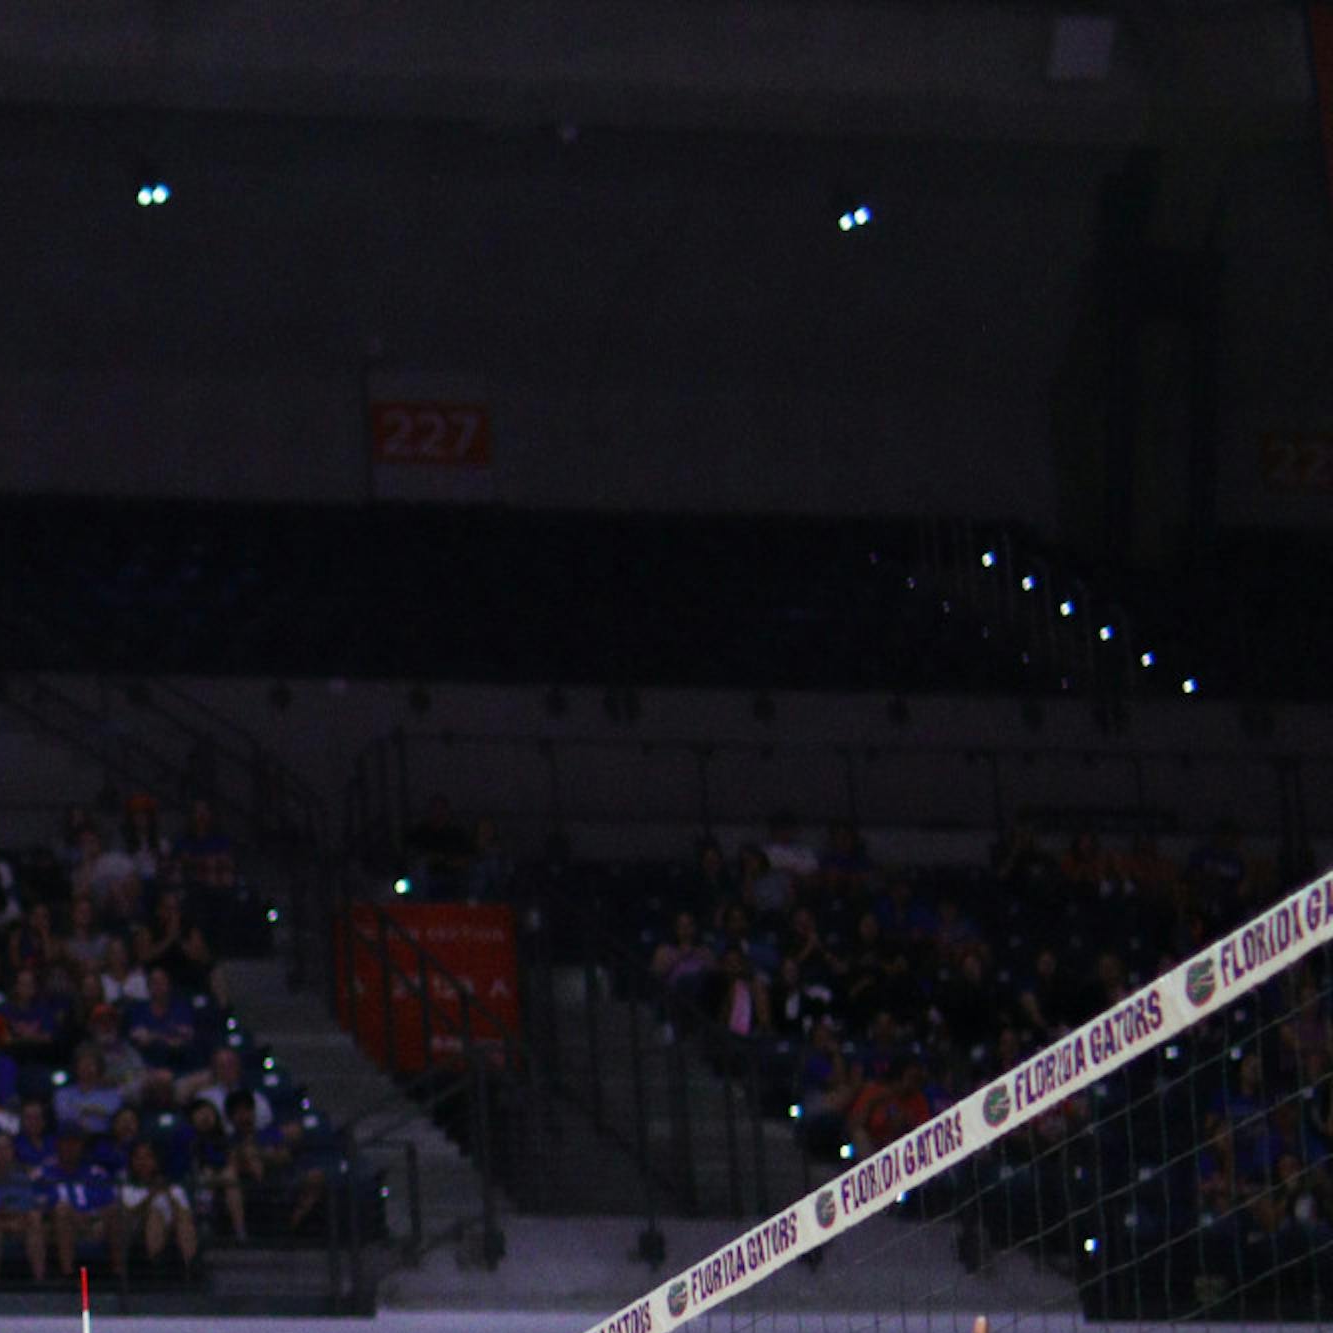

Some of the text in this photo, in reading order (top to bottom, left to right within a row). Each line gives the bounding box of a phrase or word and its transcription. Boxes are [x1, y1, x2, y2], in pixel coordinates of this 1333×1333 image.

[381, 407, 481, 459] 227
[1220, 900, 1304, 988] FLORIDA
[1015, 989, 1163, 1111] FLORIDA GATORS
[840, 1110, 963, 1215] FLORIDA GATORS
[691, 1211, 798, 1306] FLORIDA GATORS
